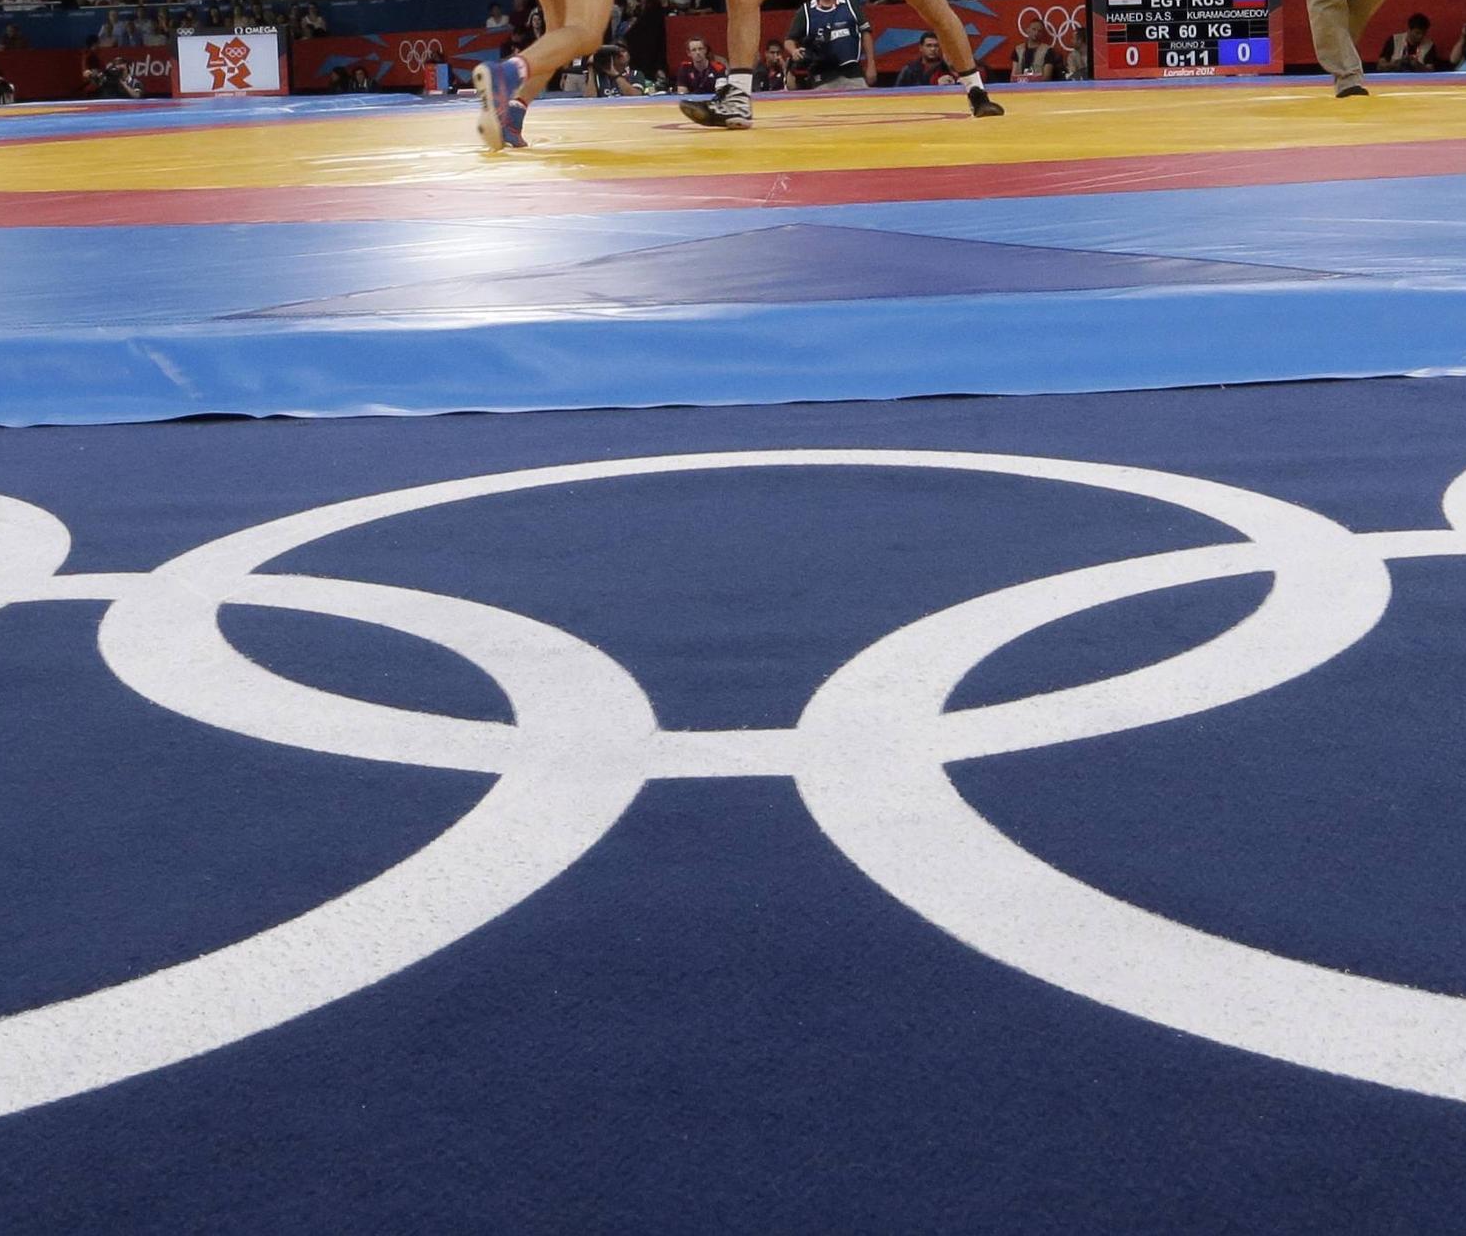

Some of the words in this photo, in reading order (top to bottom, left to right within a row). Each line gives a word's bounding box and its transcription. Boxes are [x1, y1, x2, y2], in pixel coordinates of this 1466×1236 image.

[1106, 13, 1143, 23] HAMED
[1145, 12, 1174, 21] S.A.S.
[1187, 10, 1269, 20] KURAMAGOMEDOV
[245, 26, 278, 34] OMEGA
[1146, 26, 1169, 39] GR
[1179, 25, 1196, 38] 60
[1208, 24, 1232, 37] KG
[1171, 42, 1197, 50] ROUND
[1126, 46, 1139, 66] 0
[1238, 43, 1251, 62] 0
[1166, 50, 1209, 67] 0:11
[1163, 68, 1194, 76] London
[1195, 67, 1215, 75] 2012
